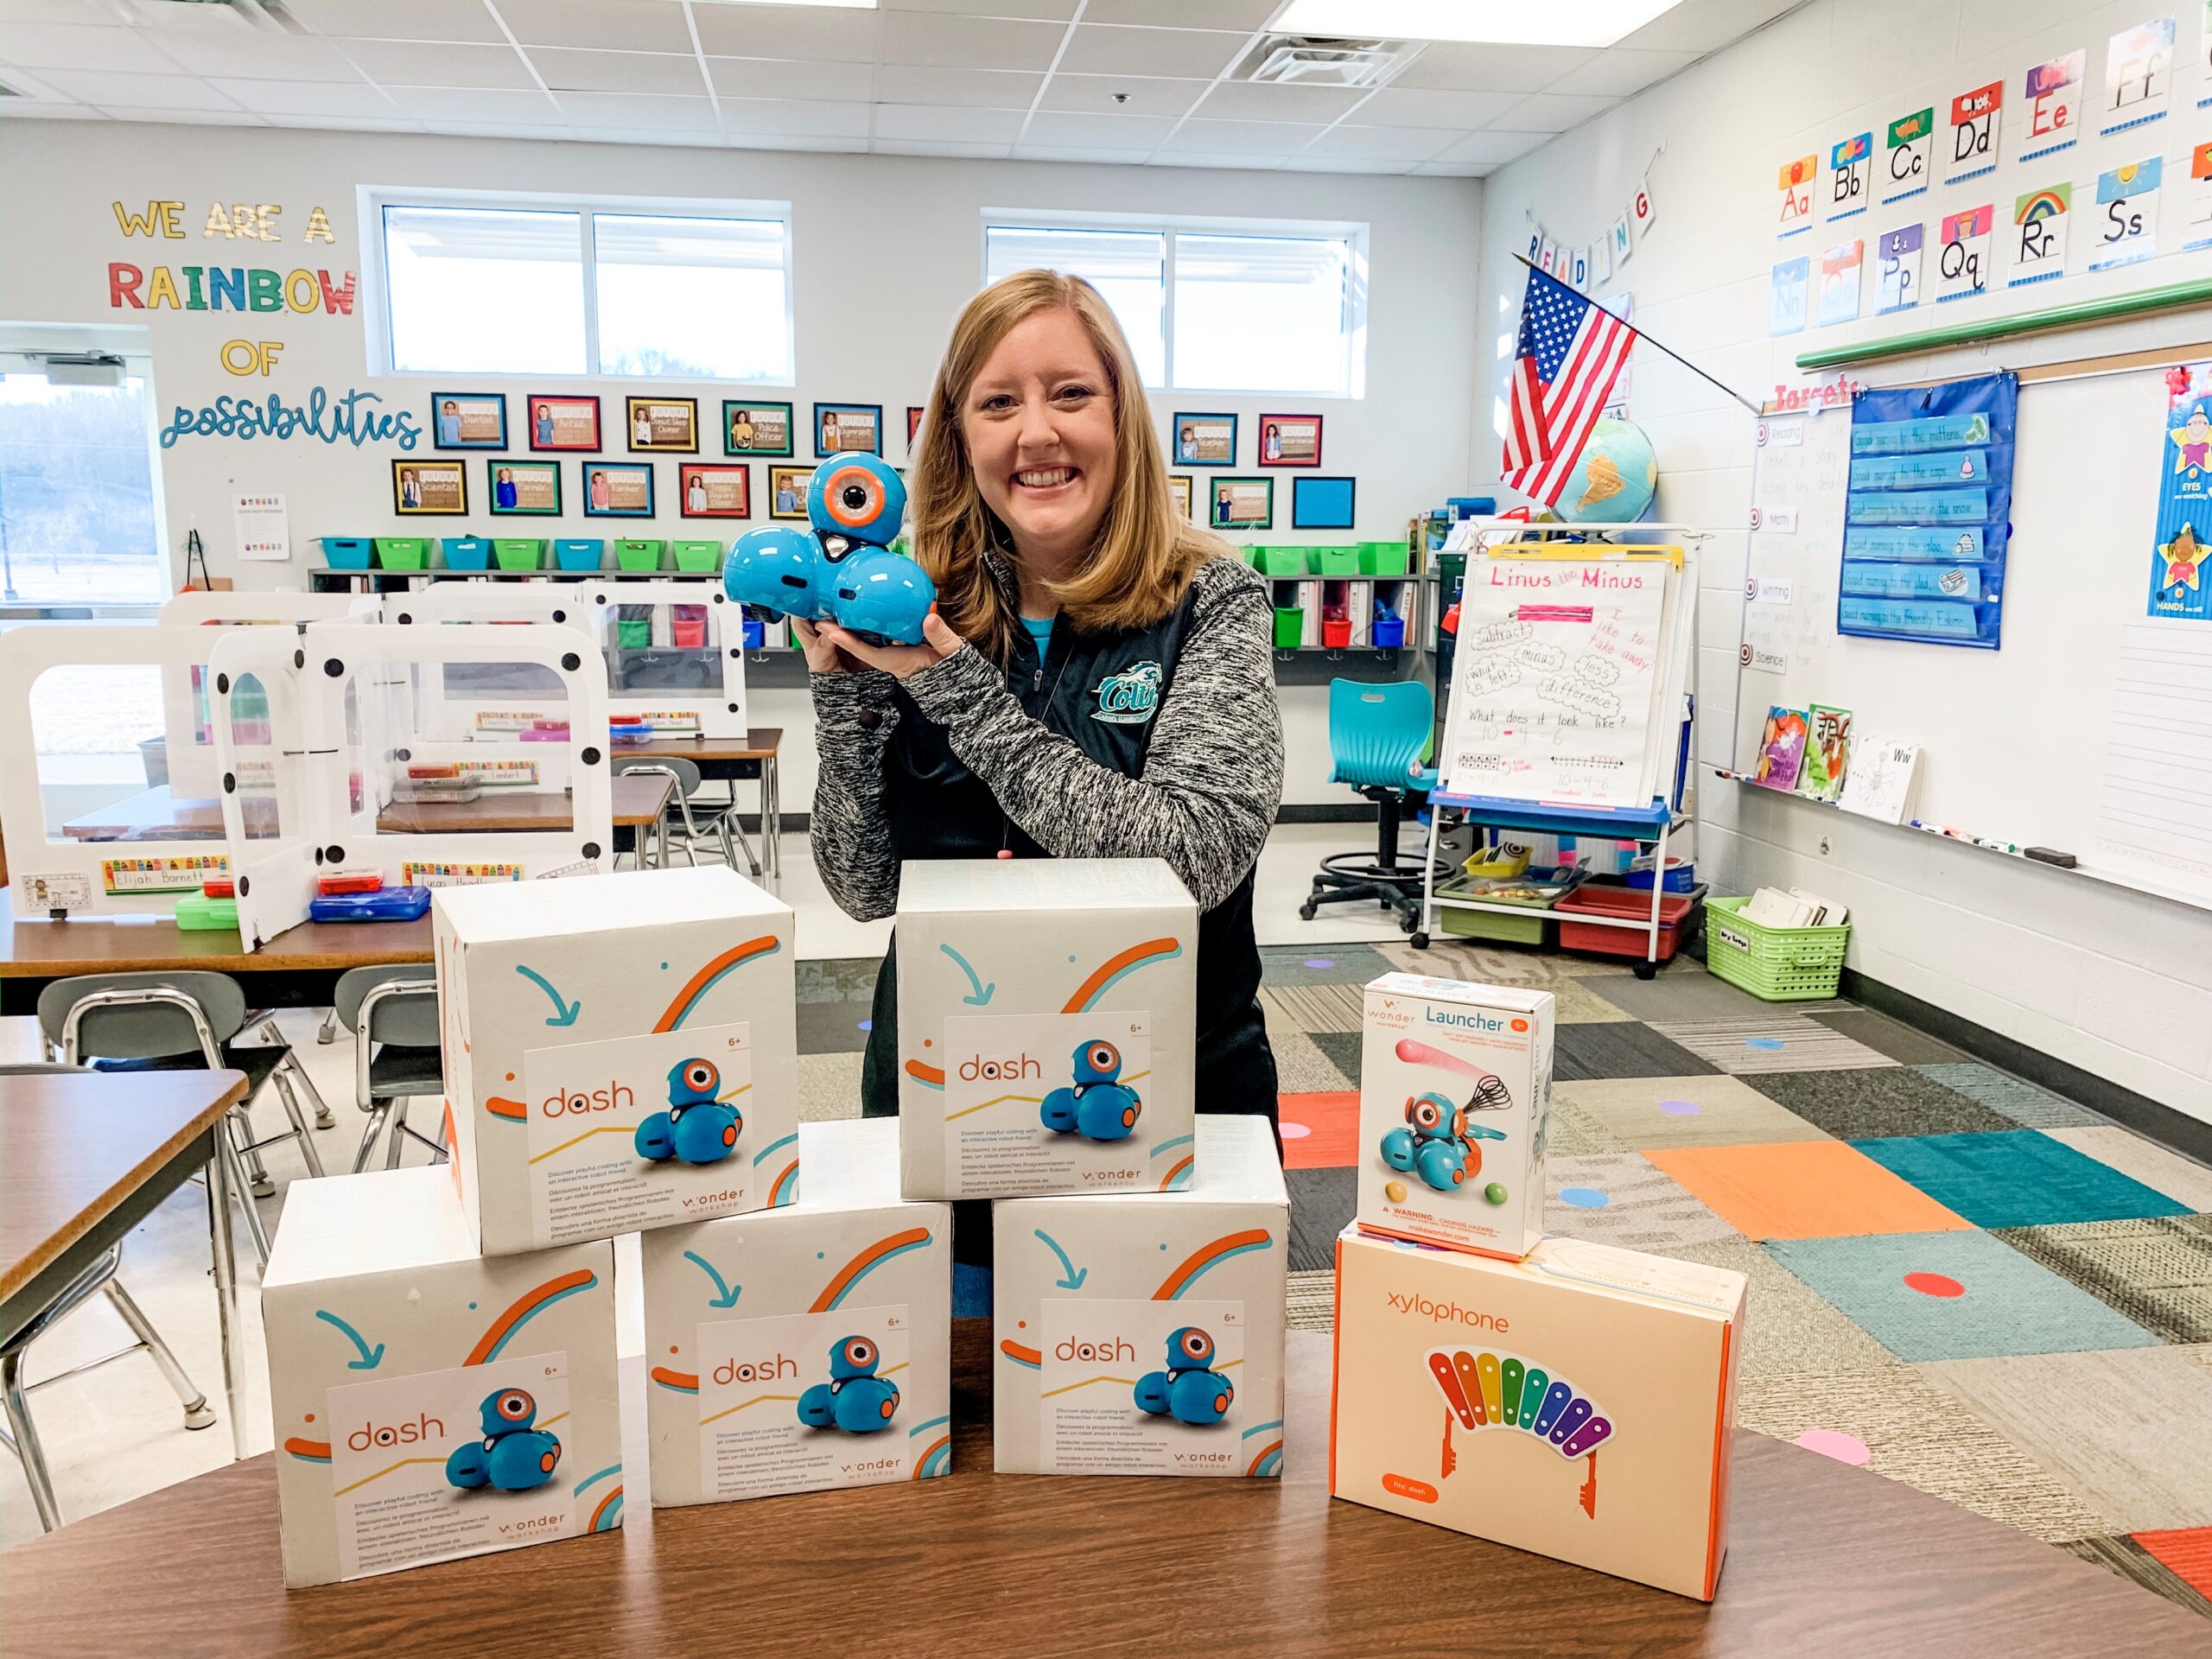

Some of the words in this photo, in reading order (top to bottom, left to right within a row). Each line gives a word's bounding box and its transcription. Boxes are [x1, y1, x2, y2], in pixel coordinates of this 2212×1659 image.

[2033, 90, 2068, 137] Ee
[1955, 112, 1991, 162] Dd
[1891, 143, 1922, 180] Cc
[1834, 162, 1860, 202] Bb
[1781, 188, 1809, 221] Aa
[112, 200, 186, 238] WE
[204, 201, 282, 242] ARE
[303, 207, 335, 244] A
[2105, 200, 2142, 242] Ss
[2021, 220, 2054, 262] Rr
[1942, 241, 1984, 289] Qq
[108, 263, 356, 315] RAINBOW
[1884, 257, 1910, 305] Pp
[220, 340, 283, 376] OF
[160, 386, 422, 450] possibilities
[754, 433, 784, 442] Officer
[421, 483, 458, 492] Scientist
[2183, 482, 2201, 492] EYES
[1491, 566, 1552, 588] Linus
[1558, 570, 1577, 584] the
[1582, 567, 1643, 588] Minus
[2157, 602, 2184, 612] HANDS
[1477, 622, 1528, 646] subtract
[1598, 621, 1618, 638] like
[1631, 631, 1643, 645] to
[1589, 633, 1615, 654] take
[1522, 650, 1555, 664] minus
[1756, 652, 1784, 667] Science
[1585, 660, 1610, 680] less
[1099, 680, 1157, 712] Colts
[1546, 678, 1611, 709] difference
[1470, 709, 1494, 722] What
[1507, 712, 1528, 725] does
[1538, 712, 1545, 725] it
[1558, 712, 1580, 728] look
[1893, 748, 1912, 765] Ww
[117, 871, 151, 887] Elijah
[162, 870, 203, 884] Barnett
[422, 877, 447, 887] Lucas
[1130, 1024, 1141, 1033] 6+
[1368, 1010, 1415, 1023] wonder
[1427, 1007, 1504, 1032] Launcher
[728, 1038, 741, 1046] 6+
[959, 1052, 1040, 1081] dash
[543, 1080, 633, 1118] dash
[557, 1174, 588, 1183] interactive
[575, 1166, 596, 1174] playful
[1082, 1168, 1141, 1181] wonder
[589, 1177, 637, 1190] programmation
[683, 1188, 746, 1207] wonder
[690, 1200, 740, 1214] workshop
[1393, 1207, 1435, 1222] WARNING:
[1468, 1224, 1494, 1234] HAZARD
[1408, 1224, 1470, 1243] makewonder.com
[888, 1318, 899, 1326] 6+
[1224, 1313, 1236, 1322] 6+
[1388, 1292, 1510, 1333] xylophone
[1055, 1336, 1135, 1363] dash
[544, 1366, 557, 1376] 6+
[713, 1353, 798, 1385] dash
[347, 1413, 444, 1452] dash
[841, 1459, 900, 1473] wonder
[1174, 1452, 1233, 1463] wonder
[848, 1470, 896, 1480] workshop
[1393, 1481, 1407, 1491] fits:
[1408, 1485, 1426, 1497] dash
[498, 1513, 566, 1534] wonder
[505, 1526, 560, 1541] workshop
